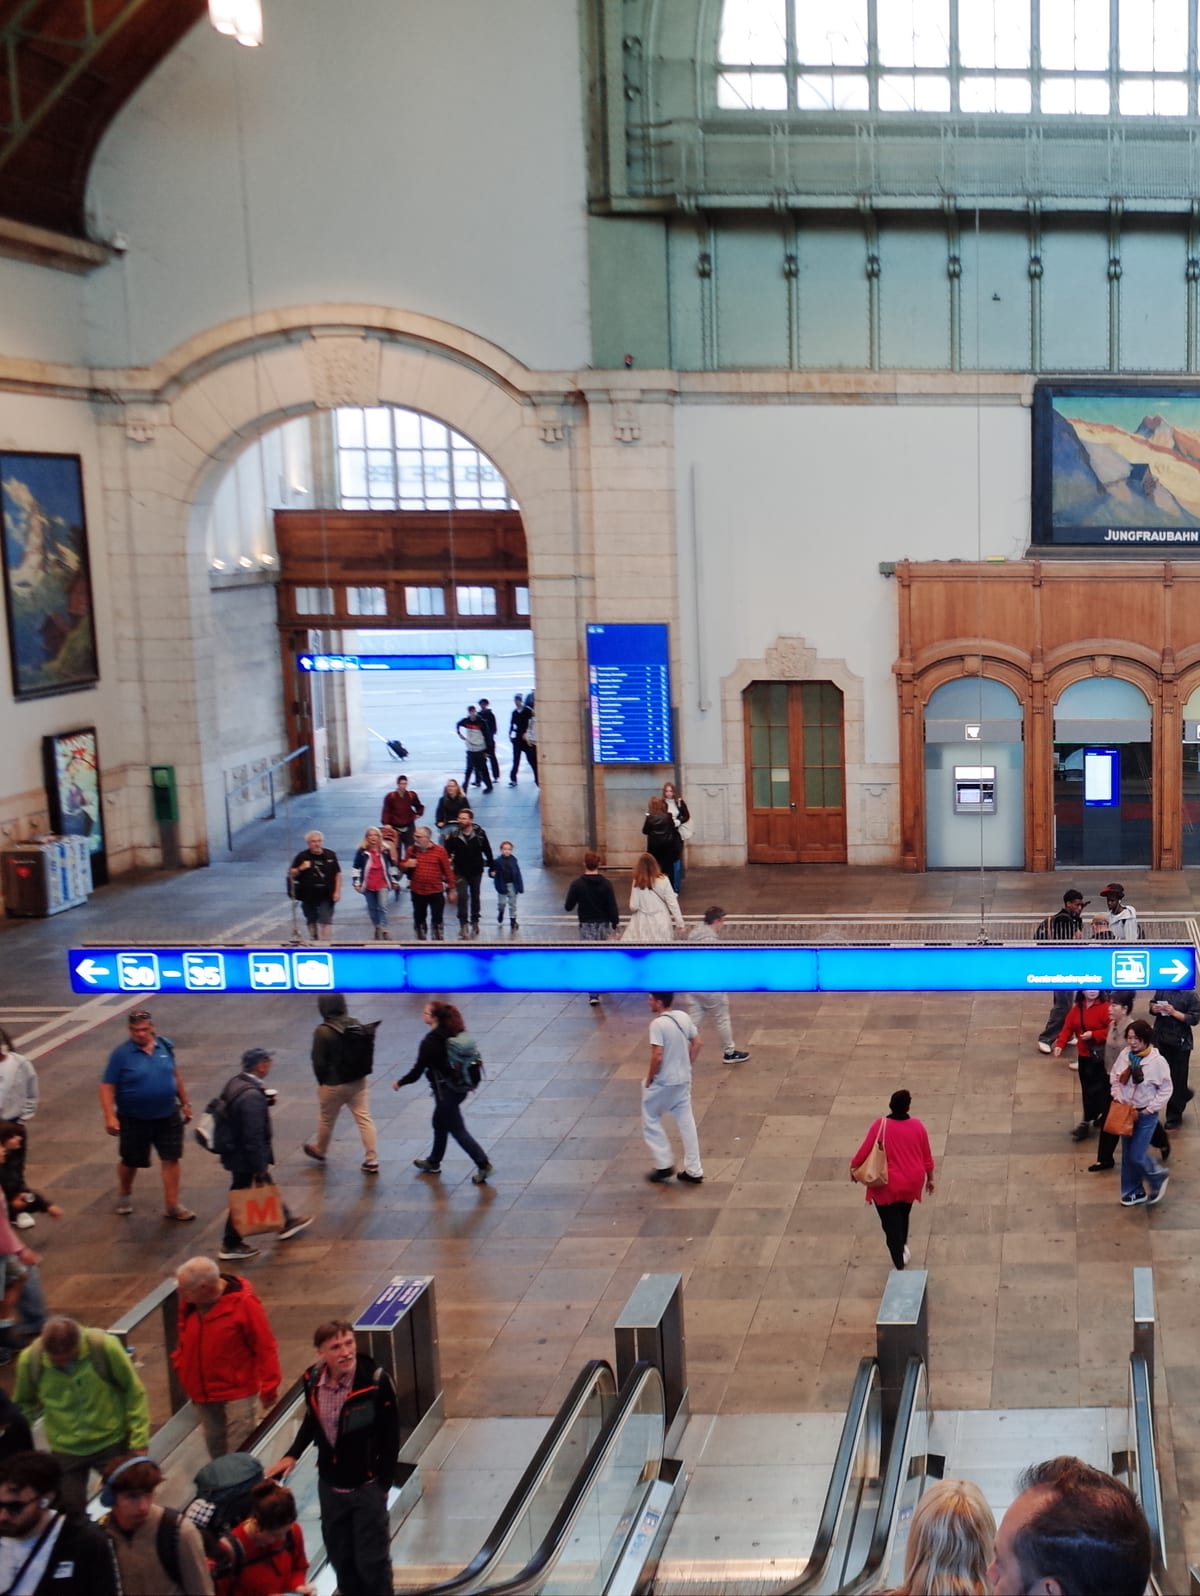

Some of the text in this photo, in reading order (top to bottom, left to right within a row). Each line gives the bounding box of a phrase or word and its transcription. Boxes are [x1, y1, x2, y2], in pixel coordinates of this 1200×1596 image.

[1104, 529, 1199, 542] JUNGFRAUBAHN
[189, 966, 221, 987] 35
[246, 1195, 277, 1227] M
